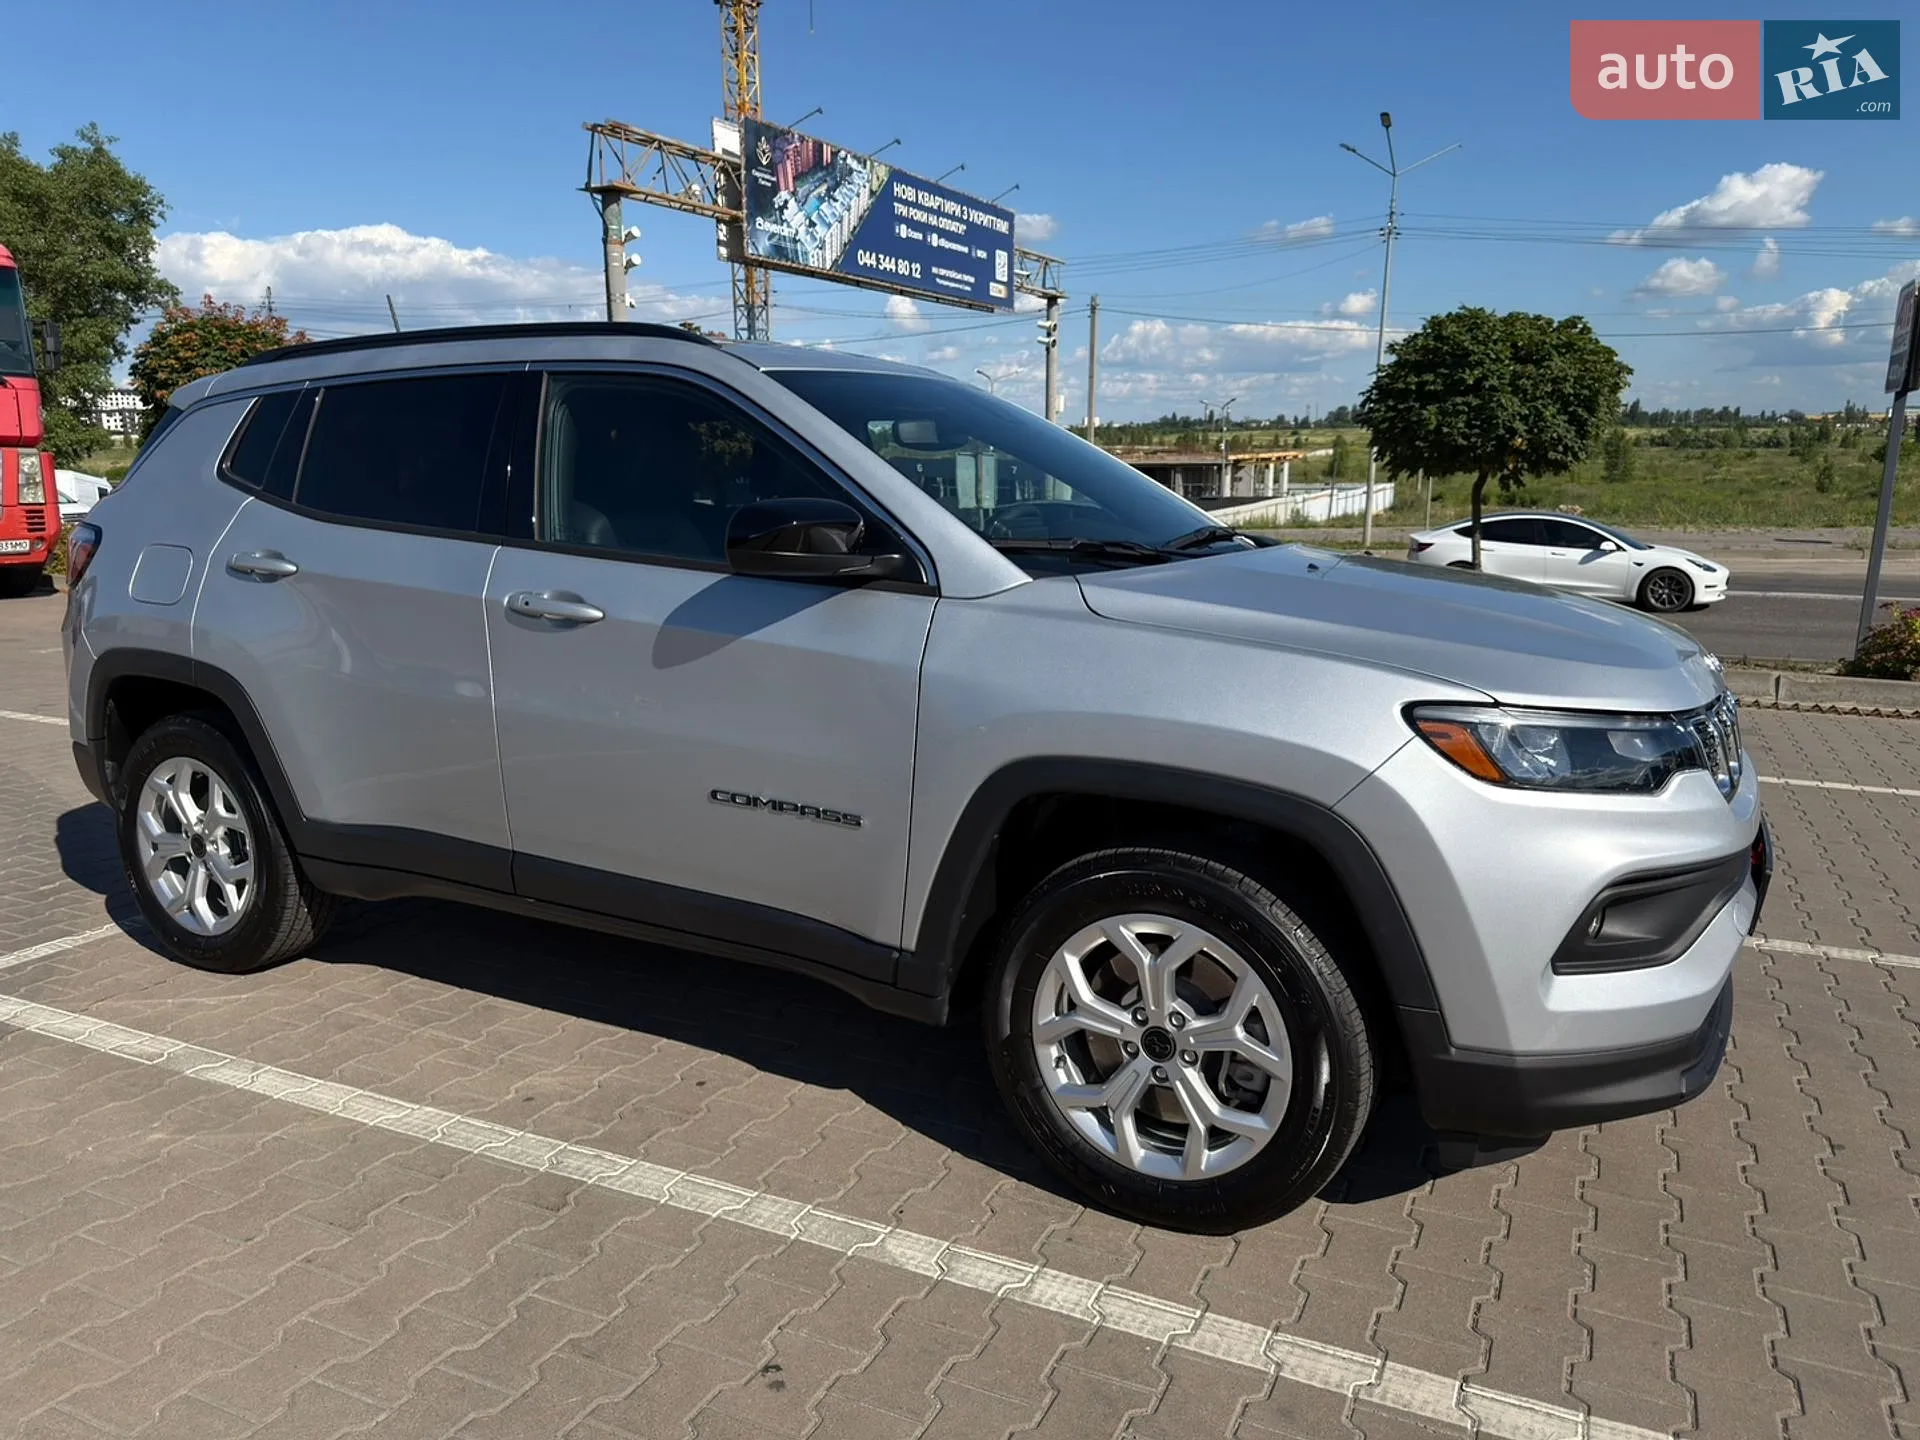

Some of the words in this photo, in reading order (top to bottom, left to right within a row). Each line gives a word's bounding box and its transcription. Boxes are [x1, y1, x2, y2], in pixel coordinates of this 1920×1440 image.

[893, 181, 916, 203] НОВІ
[917, 189, 962, 218] КВАРТИРИ
[893, 202, 908, 218] ТРИ
[857, 249, 876, 269] 044
[878, 253, 896, 272] 344
[897, 258, 910, 276] 80
[911, 262, 921, 279] 12
[710, 789, 864, 829] COMPASS
